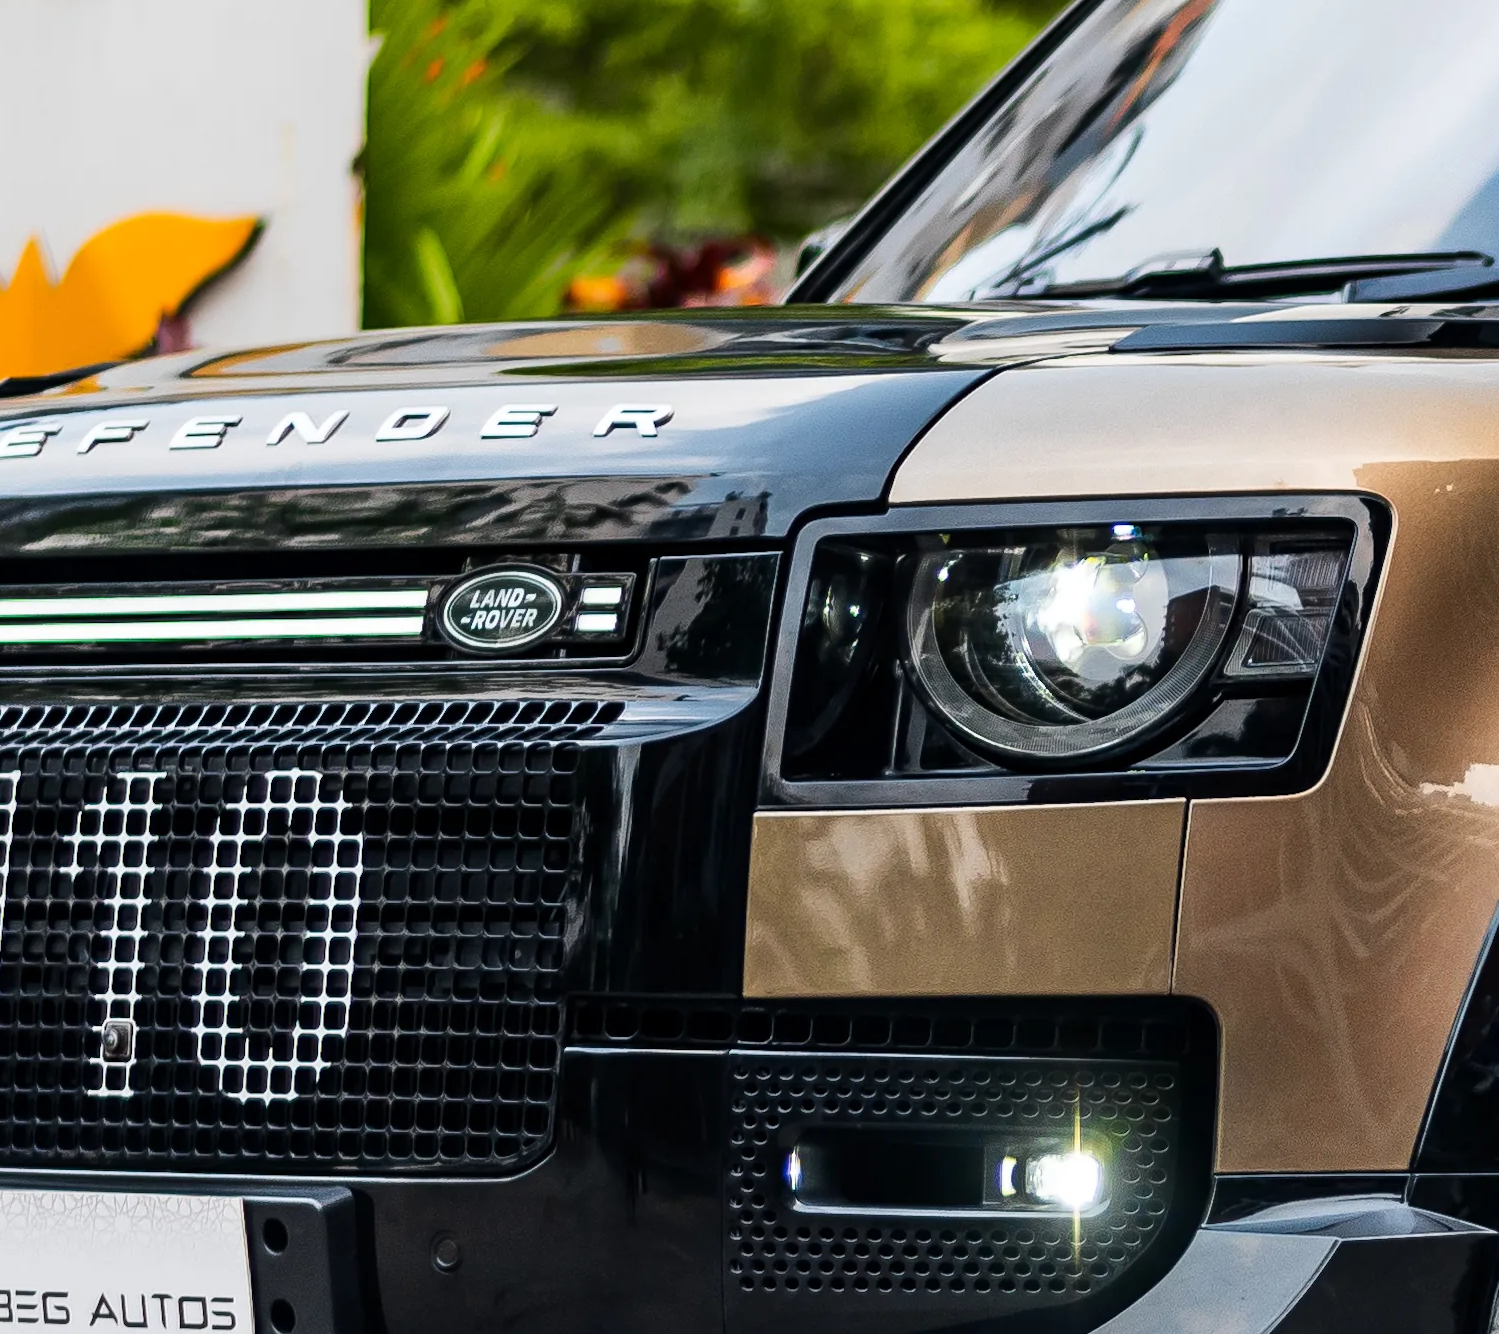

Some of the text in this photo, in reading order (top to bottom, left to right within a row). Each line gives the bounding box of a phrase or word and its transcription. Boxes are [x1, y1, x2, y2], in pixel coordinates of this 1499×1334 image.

[469, 587, 525, 610] LAND
[470, 608, 538, 631] ROVER
[88, 1292, 237, 1331] AUTOS
